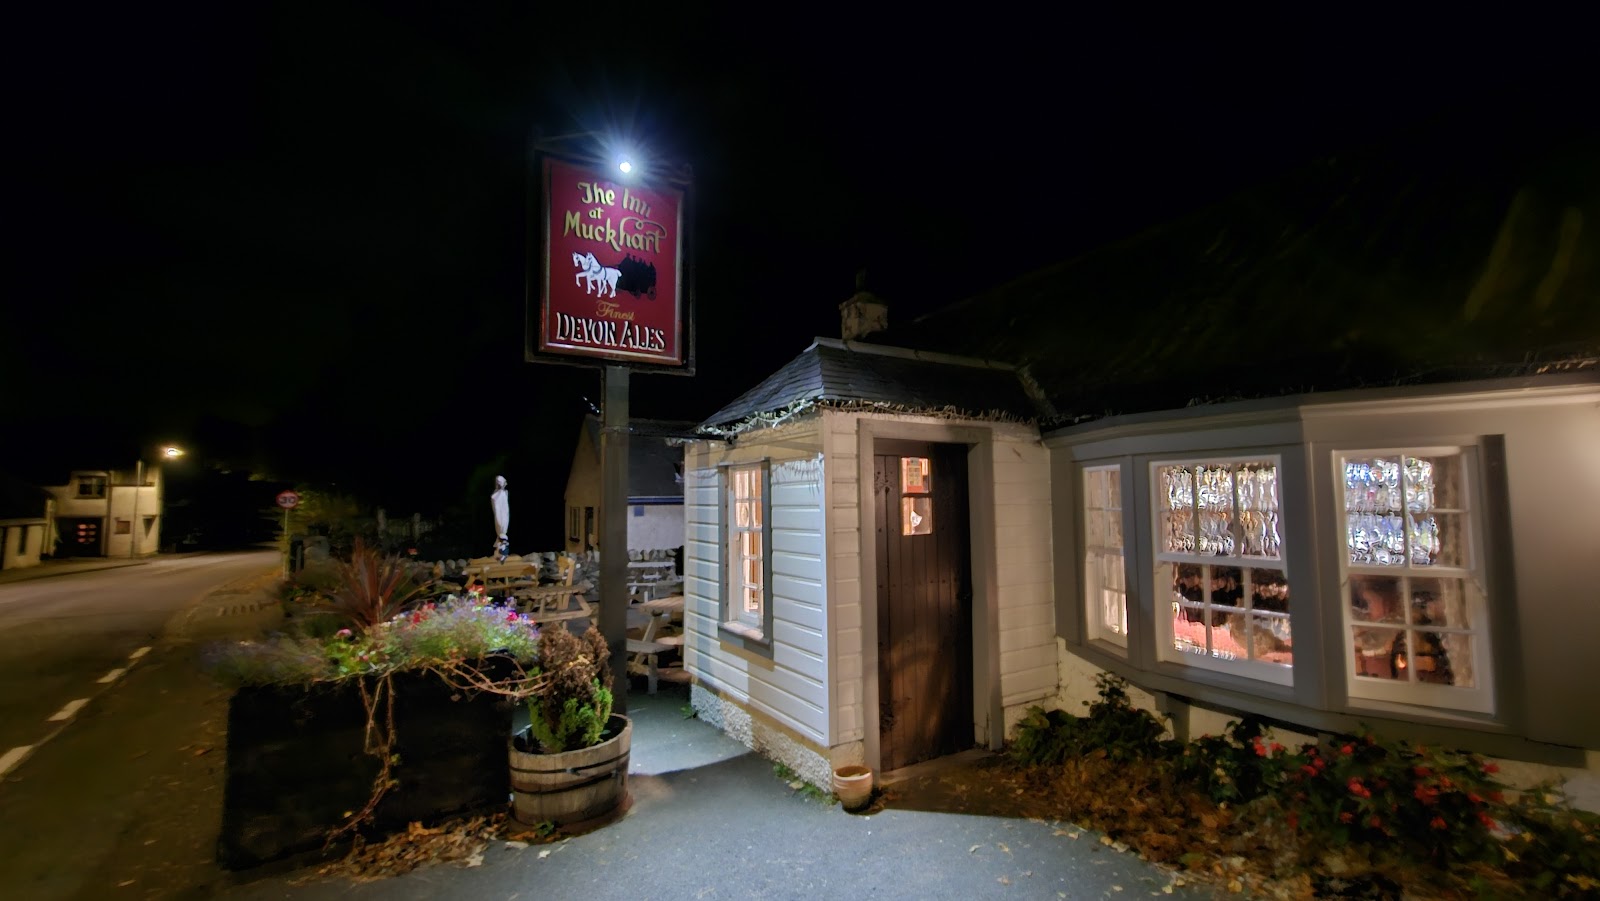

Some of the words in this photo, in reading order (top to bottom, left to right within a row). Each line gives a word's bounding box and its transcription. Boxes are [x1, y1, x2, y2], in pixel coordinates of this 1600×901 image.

[578, 182, 615, 206] The
[622, 188, 651, 217] Inn
[589, 207, 604, 219] at
[563, 210, 667, 254] Muckhart
[595, 300, 635, 321] Finest
[556, 312, 616, 347] DEVON
[620, 321, 666, 352] ALES
